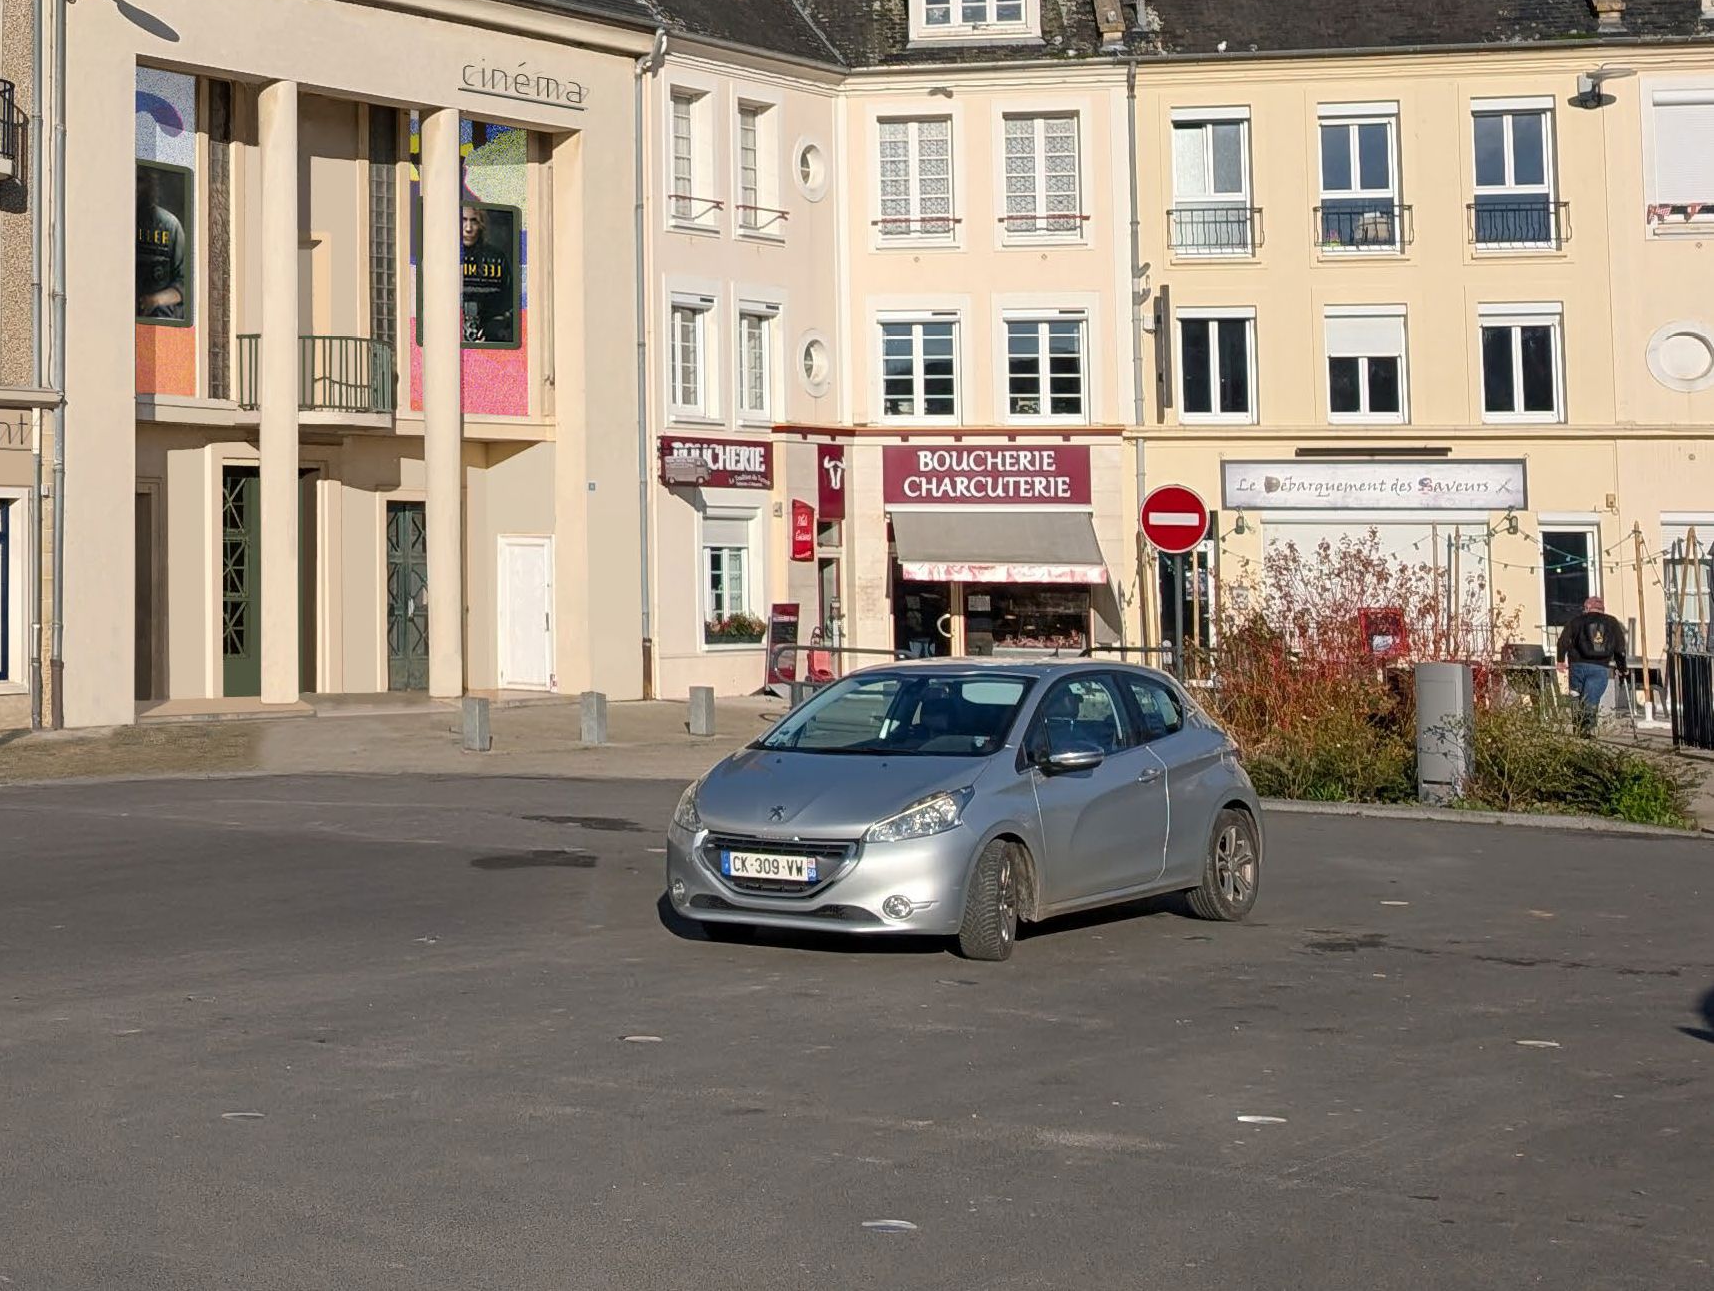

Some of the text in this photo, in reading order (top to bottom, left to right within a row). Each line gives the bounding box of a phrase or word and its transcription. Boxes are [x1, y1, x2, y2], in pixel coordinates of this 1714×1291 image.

[462, 58, 583, 104] cinéma
[917, 450, 1057, 472] BOUCHERIE
[903, 476, 1072, 498] CHARCUTERIE
[1236, 475, 1489, 497] Le Débarquement des Saveurs
